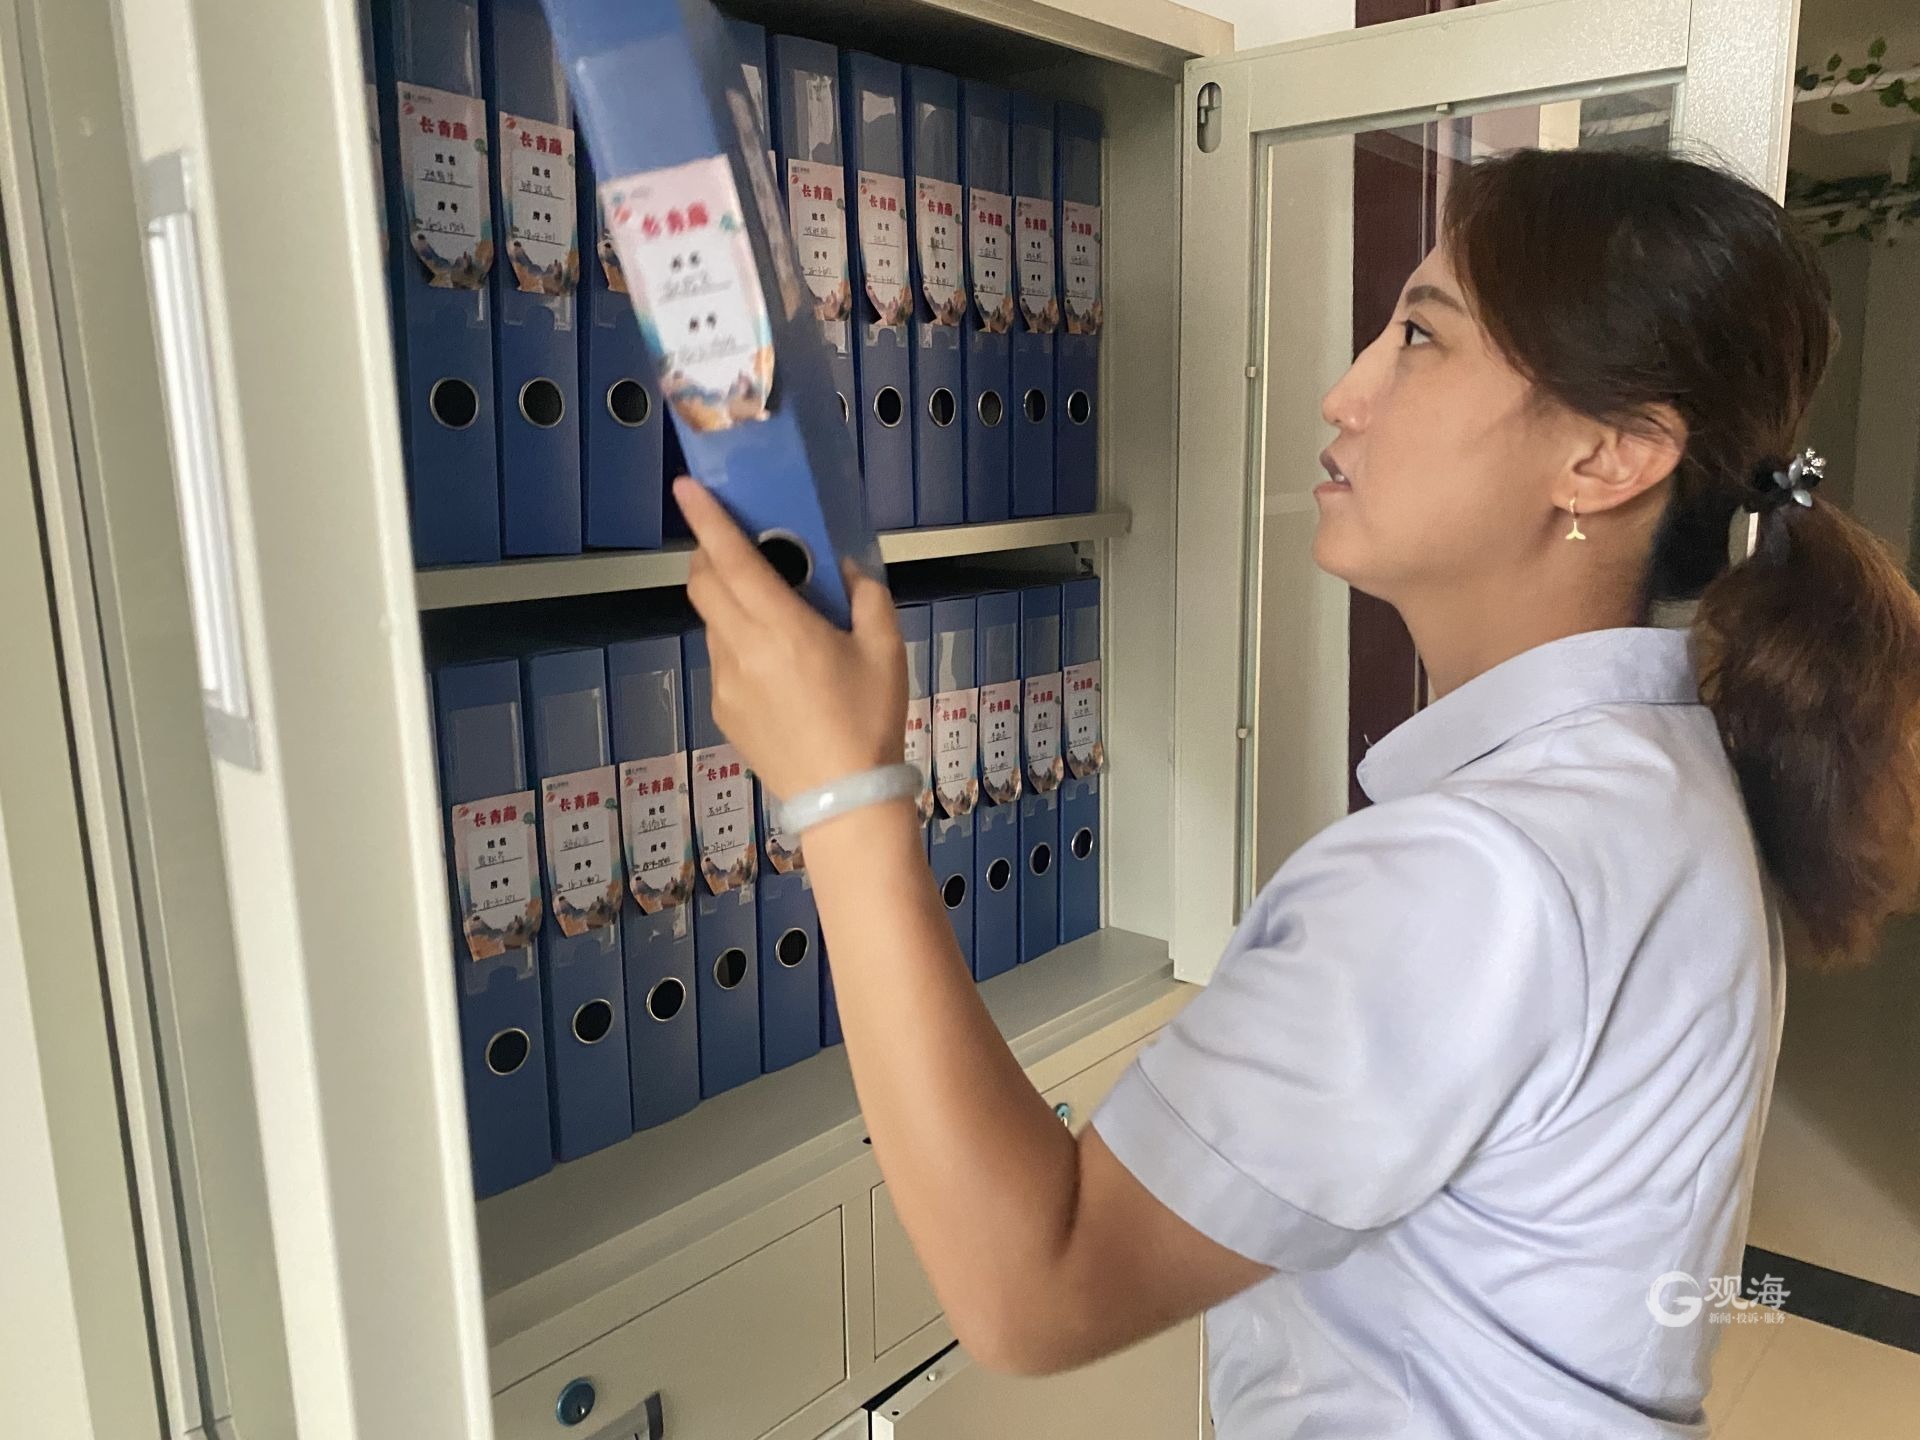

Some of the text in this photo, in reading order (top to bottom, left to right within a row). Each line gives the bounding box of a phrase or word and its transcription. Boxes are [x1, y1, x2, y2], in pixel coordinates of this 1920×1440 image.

[420, 116, 468, 140] 长青藤
[520, 131, 562, 156] 长青藤
[802, 184, 833, 201] 长青藤
[869, 195, 897, 212] 长青藤
[943, 707, 967, 721] 长青藤
[907, 718, 923, 730] 青藤
[707, 763, 740, 781] 长青藤
[637, 776, 674, 796] 长青藤
[559, 792, 600, 812] 长青藤
[473, 805, 517, 827] 长青藤
